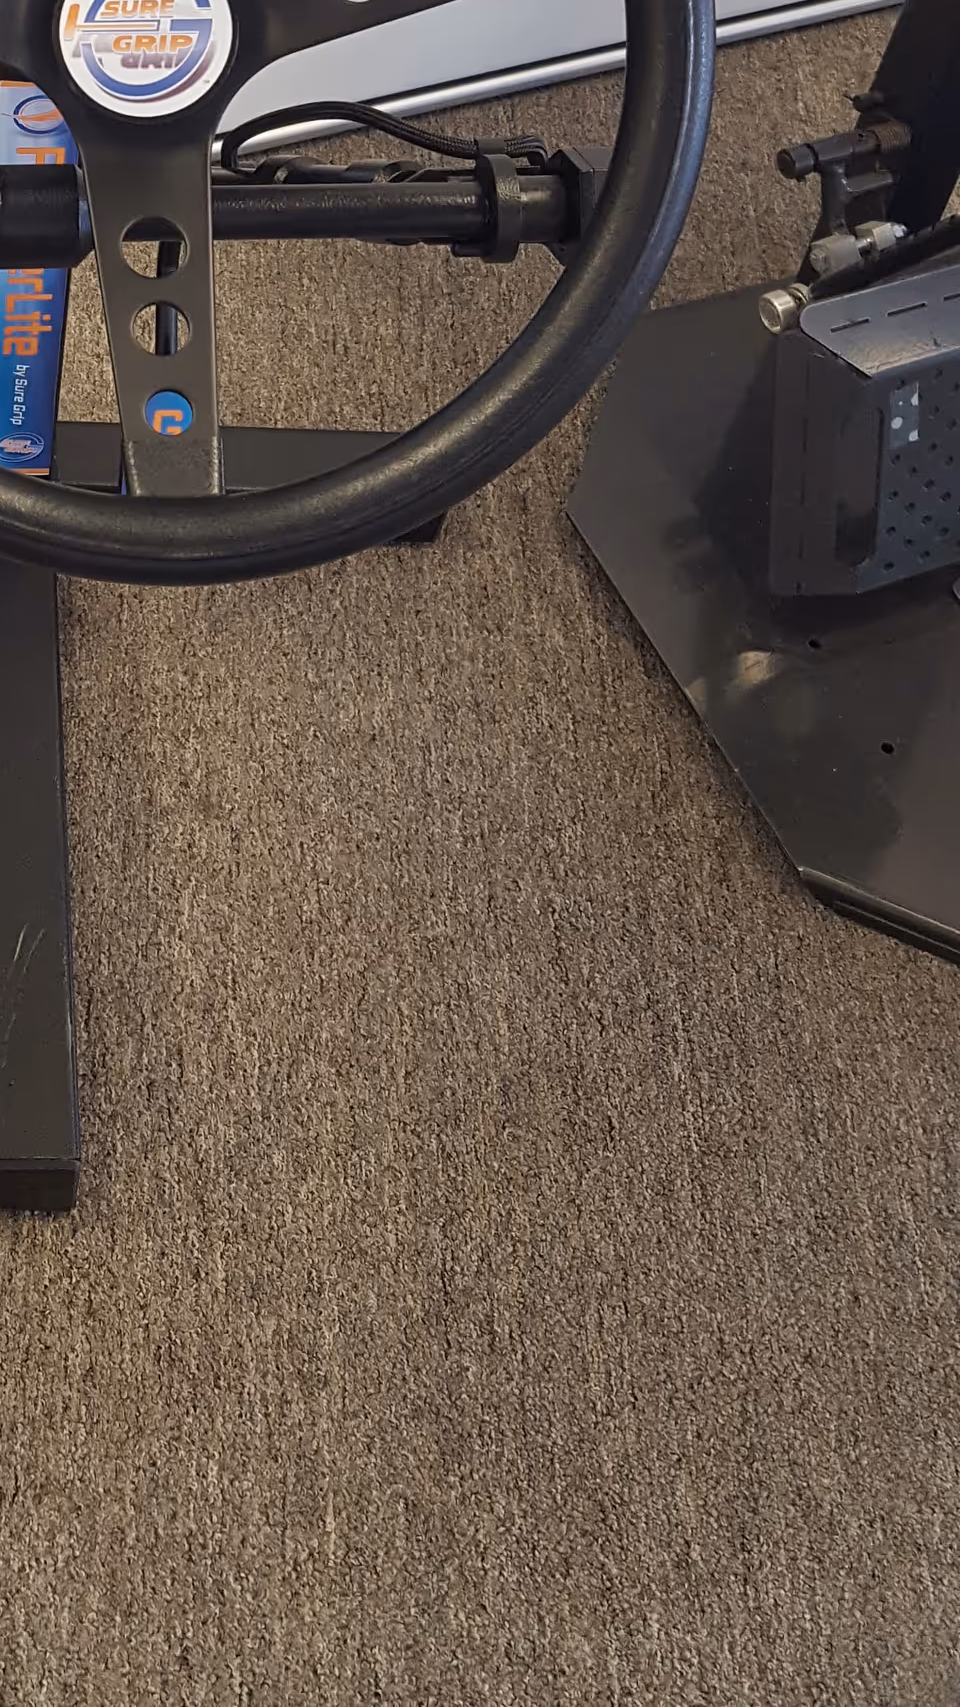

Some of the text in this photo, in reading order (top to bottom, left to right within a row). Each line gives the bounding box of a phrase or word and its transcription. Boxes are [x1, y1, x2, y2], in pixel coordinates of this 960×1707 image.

[100, 0, 174, 18] SURE
[112, 34, 193, 53] GRIP
[9, 364, 30, 426] by Sure Grip
